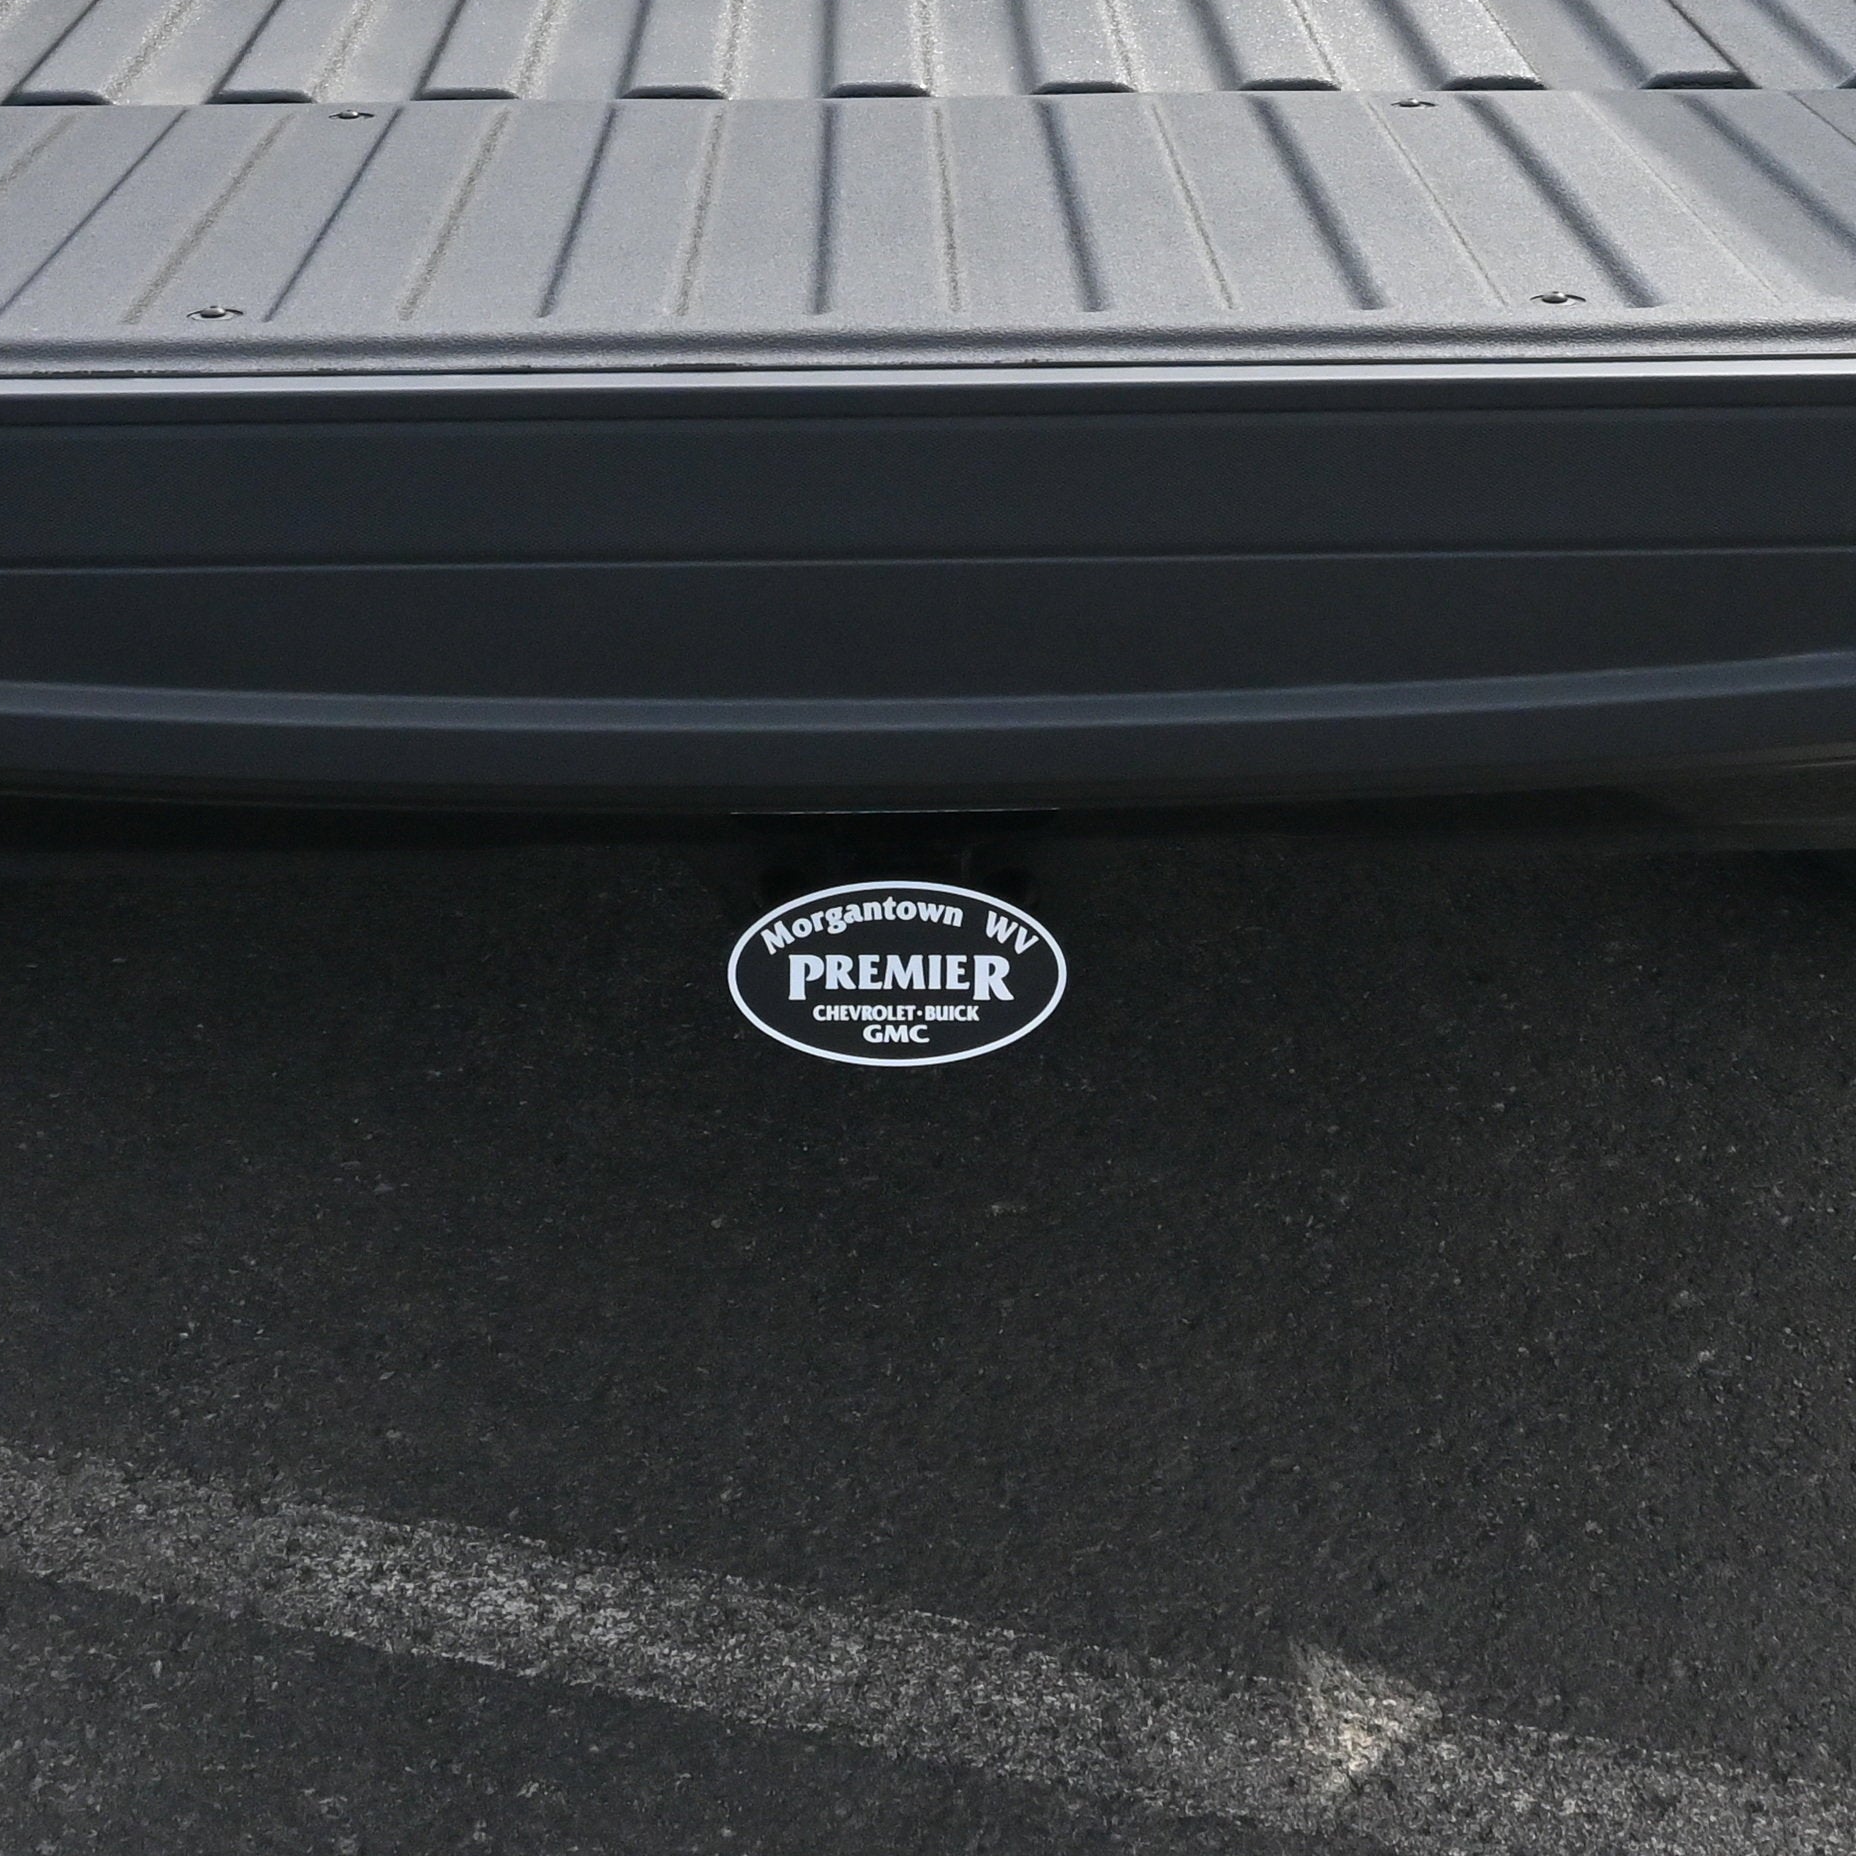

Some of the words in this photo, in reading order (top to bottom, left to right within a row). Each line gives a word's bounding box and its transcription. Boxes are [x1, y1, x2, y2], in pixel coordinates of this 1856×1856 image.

[759, 895, 965, 956] Morgantown
[985, 910, 1041, 955] WV
[787, 954, 1015, 1001] PREMIER
[863, 1024, 930, 1043] GMC
